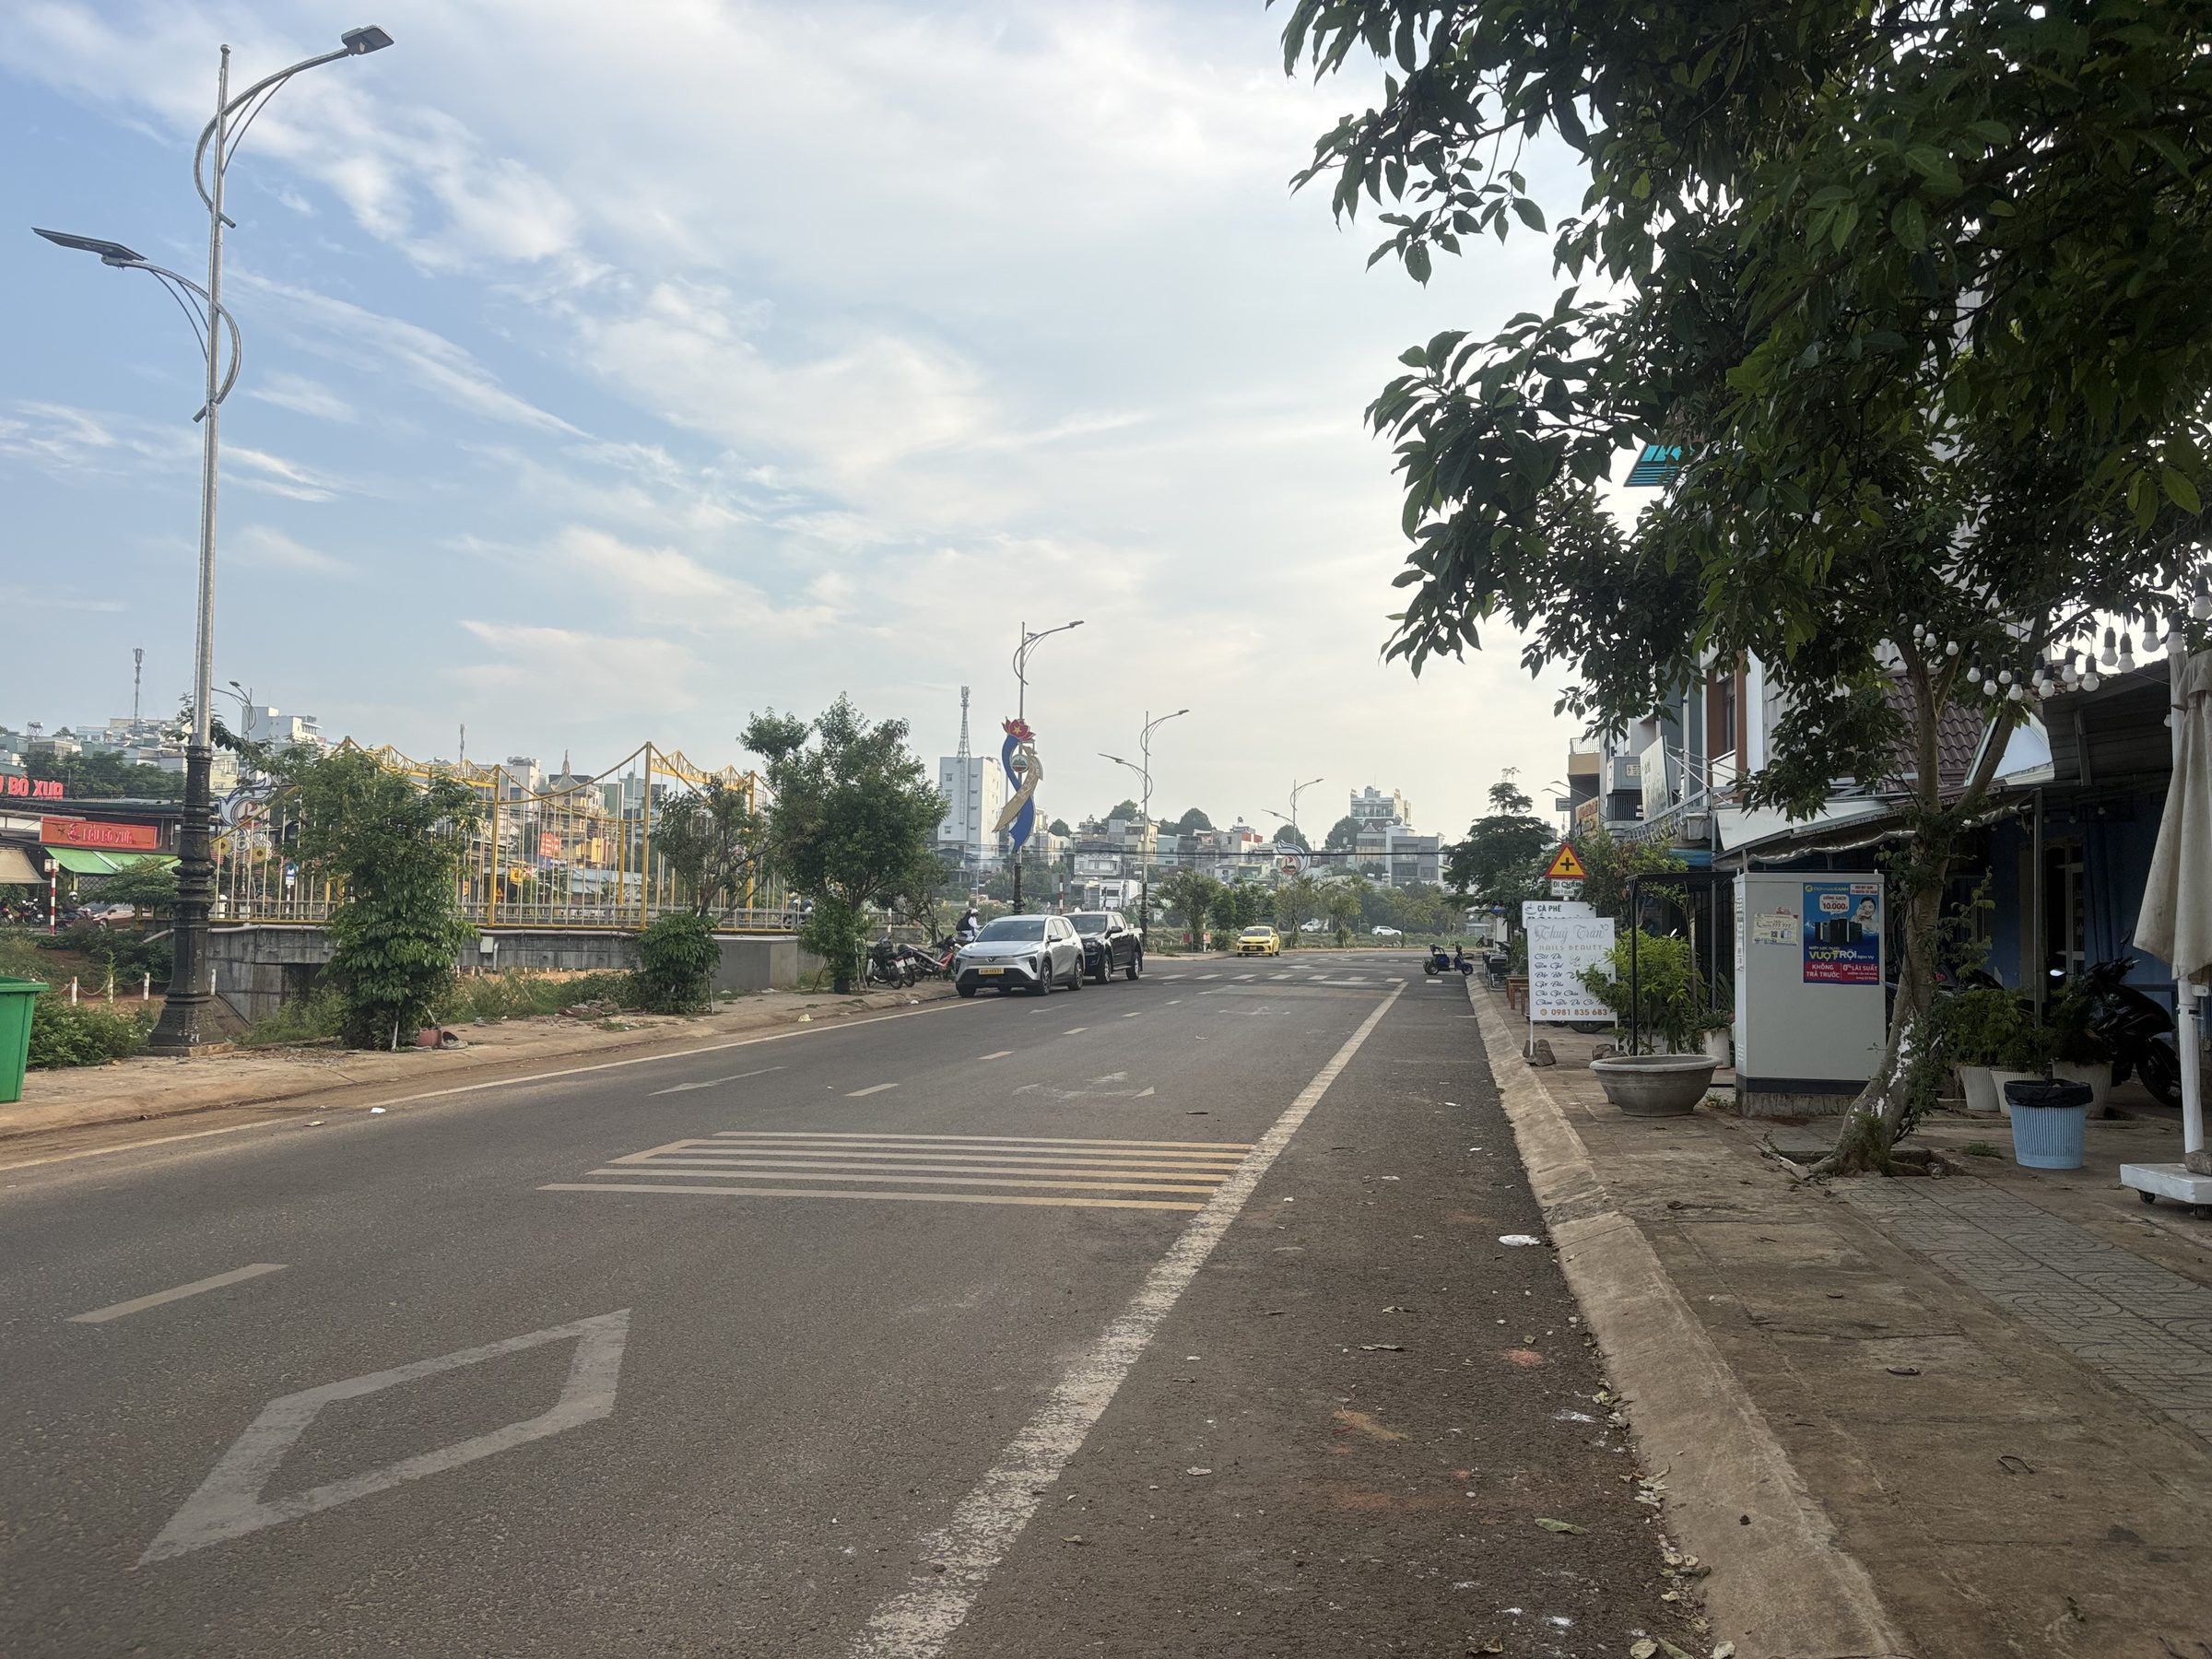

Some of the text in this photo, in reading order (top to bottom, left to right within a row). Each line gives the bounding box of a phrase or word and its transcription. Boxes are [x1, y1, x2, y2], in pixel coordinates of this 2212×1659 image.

[8, 773, 29, 796] BÒ
[1537, 904, 1561, 912] CÀ PHÊ
